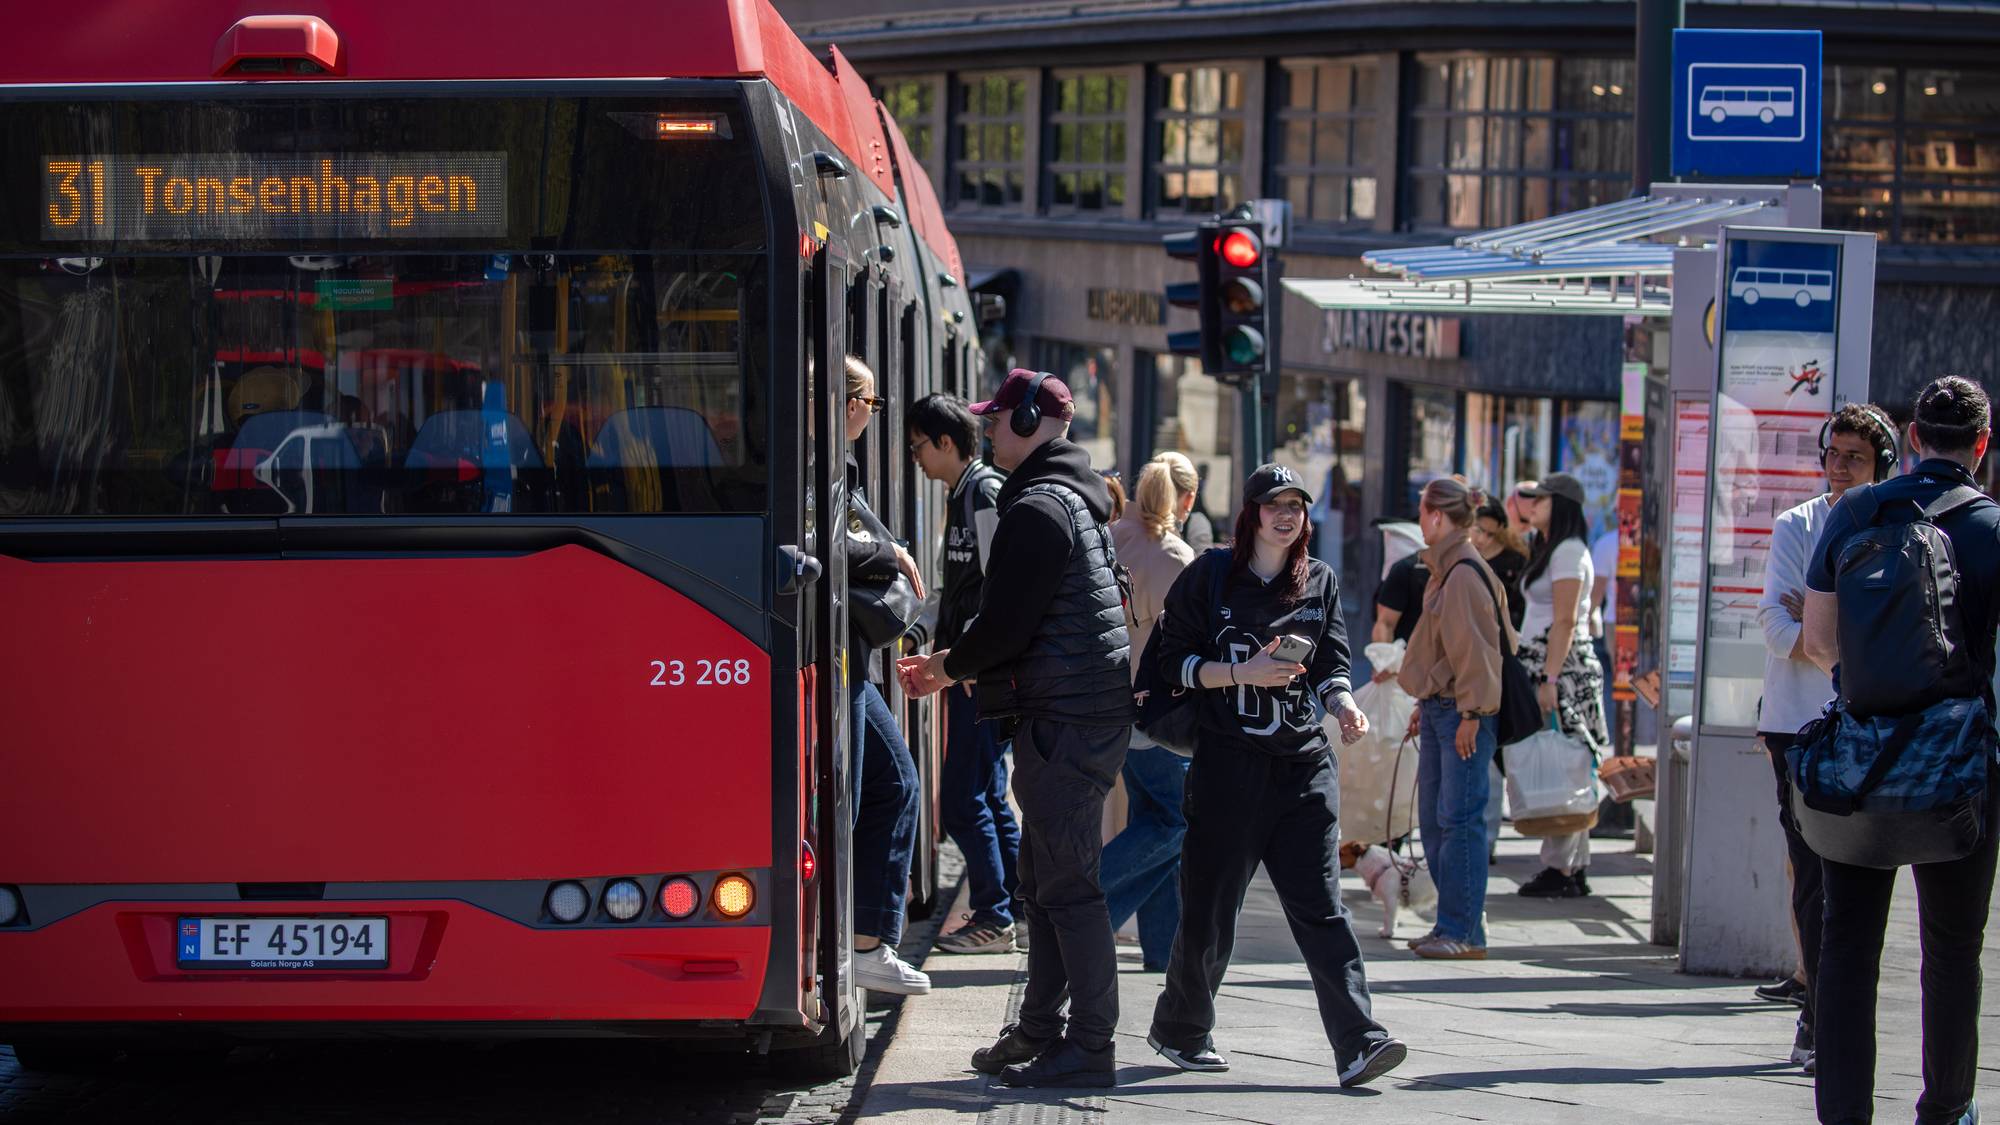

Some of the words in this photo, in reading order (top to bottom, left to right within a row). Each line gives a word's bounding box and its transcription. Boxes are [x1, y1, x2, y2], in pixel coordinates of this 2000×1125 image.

[48, 161, 104, 227] 31
[135, 159, 478, 227] Tonsenhagen
[1324, 309, 1443, 359] NARVESEN
[650, 659, 686, 687] 23
[696, 658, 751, 686] 268
[185, 945, 195, 954] N
[213, 923, 251, 956] EF
[267, 923, 373, 956] 45194
[250, 960, 277, 968] Solaris
[278, 960, 302, 969] Norge
[303, 960, 314, 968] AS
